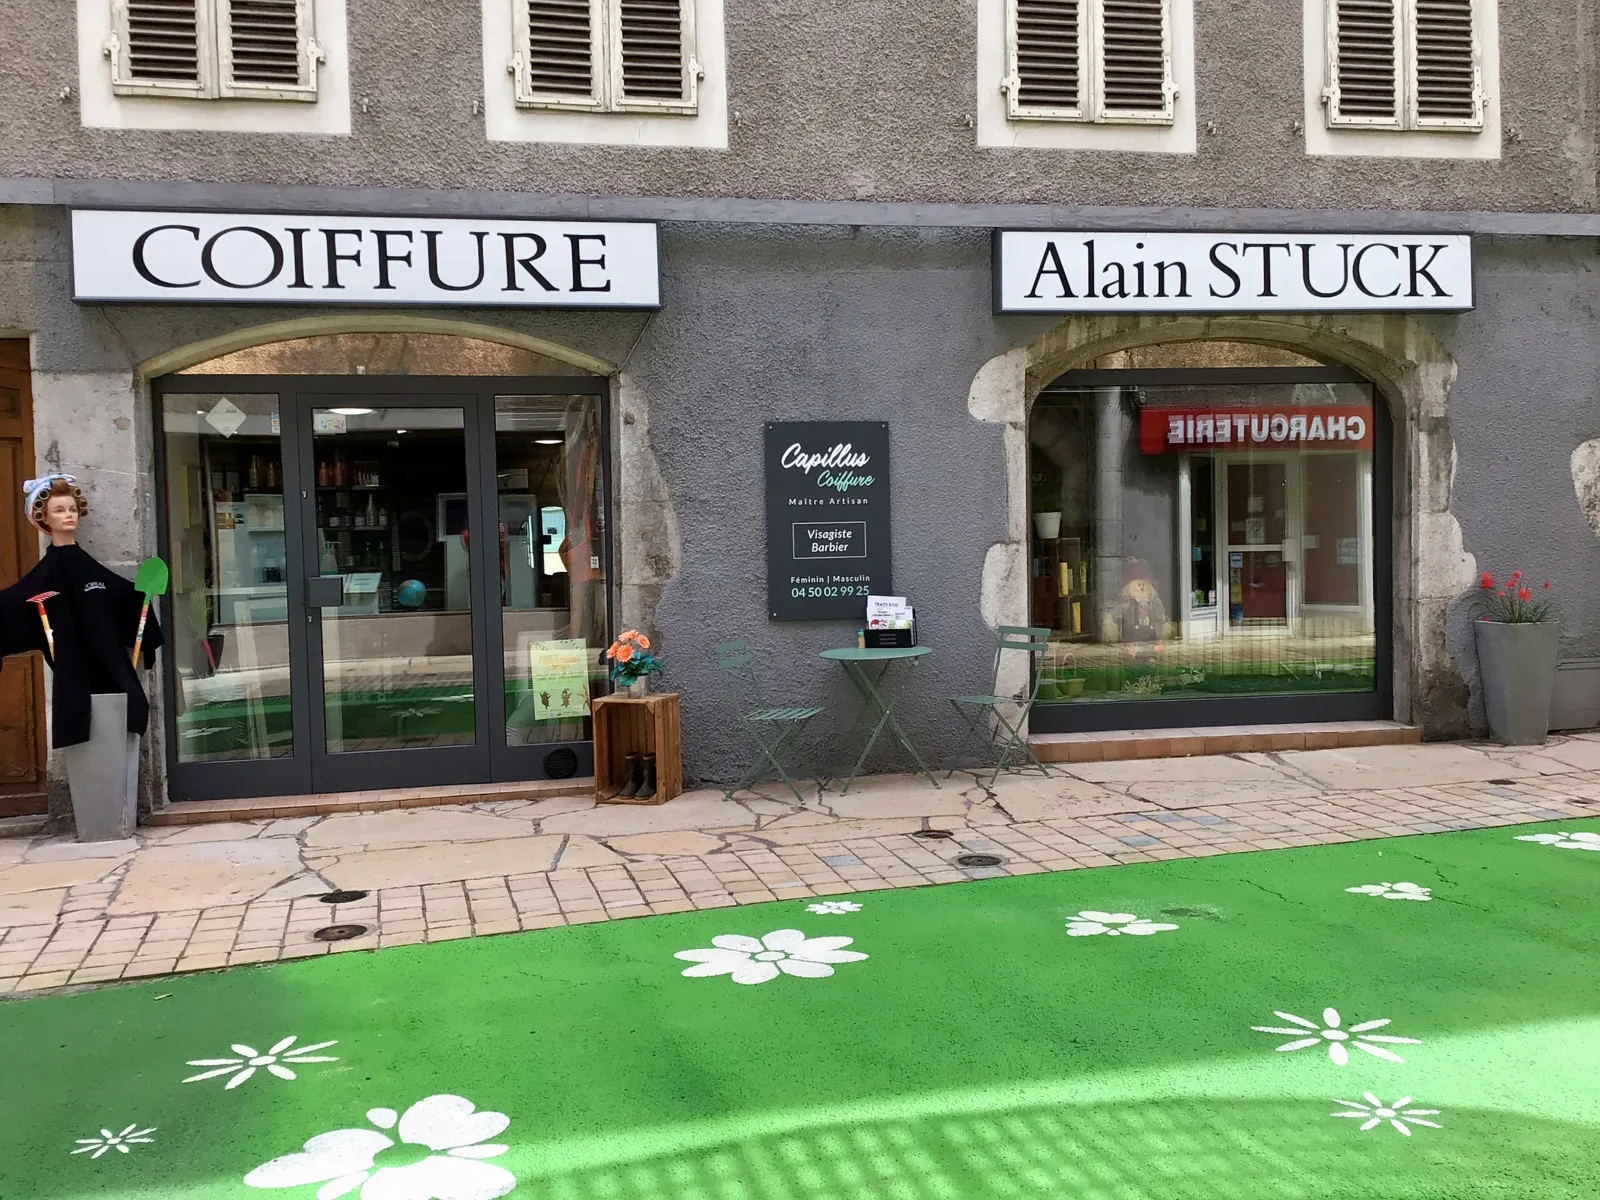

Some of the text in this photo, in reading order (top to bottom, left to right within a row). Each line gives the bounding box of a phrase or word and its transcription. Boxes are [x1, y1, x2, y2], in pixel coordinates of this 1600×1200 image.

[133, 224, 611, 293] COIFFURE
[1023, 239, 1453, 299] Alain STUCK
[781, 443, 870, 474] Capillus
[817, 470, 875, 492] Coiffure
[789, 497, 868, 506] Maître Artisan
[807, 529, 852, 540] Visagiste
[811, 542, 849, 553] Barbier
[790, 575, 824, 584] Féminin
[833, 574, 871, 583] Masculin
[791, 586, 870, 598] 04 50 02 99 25
